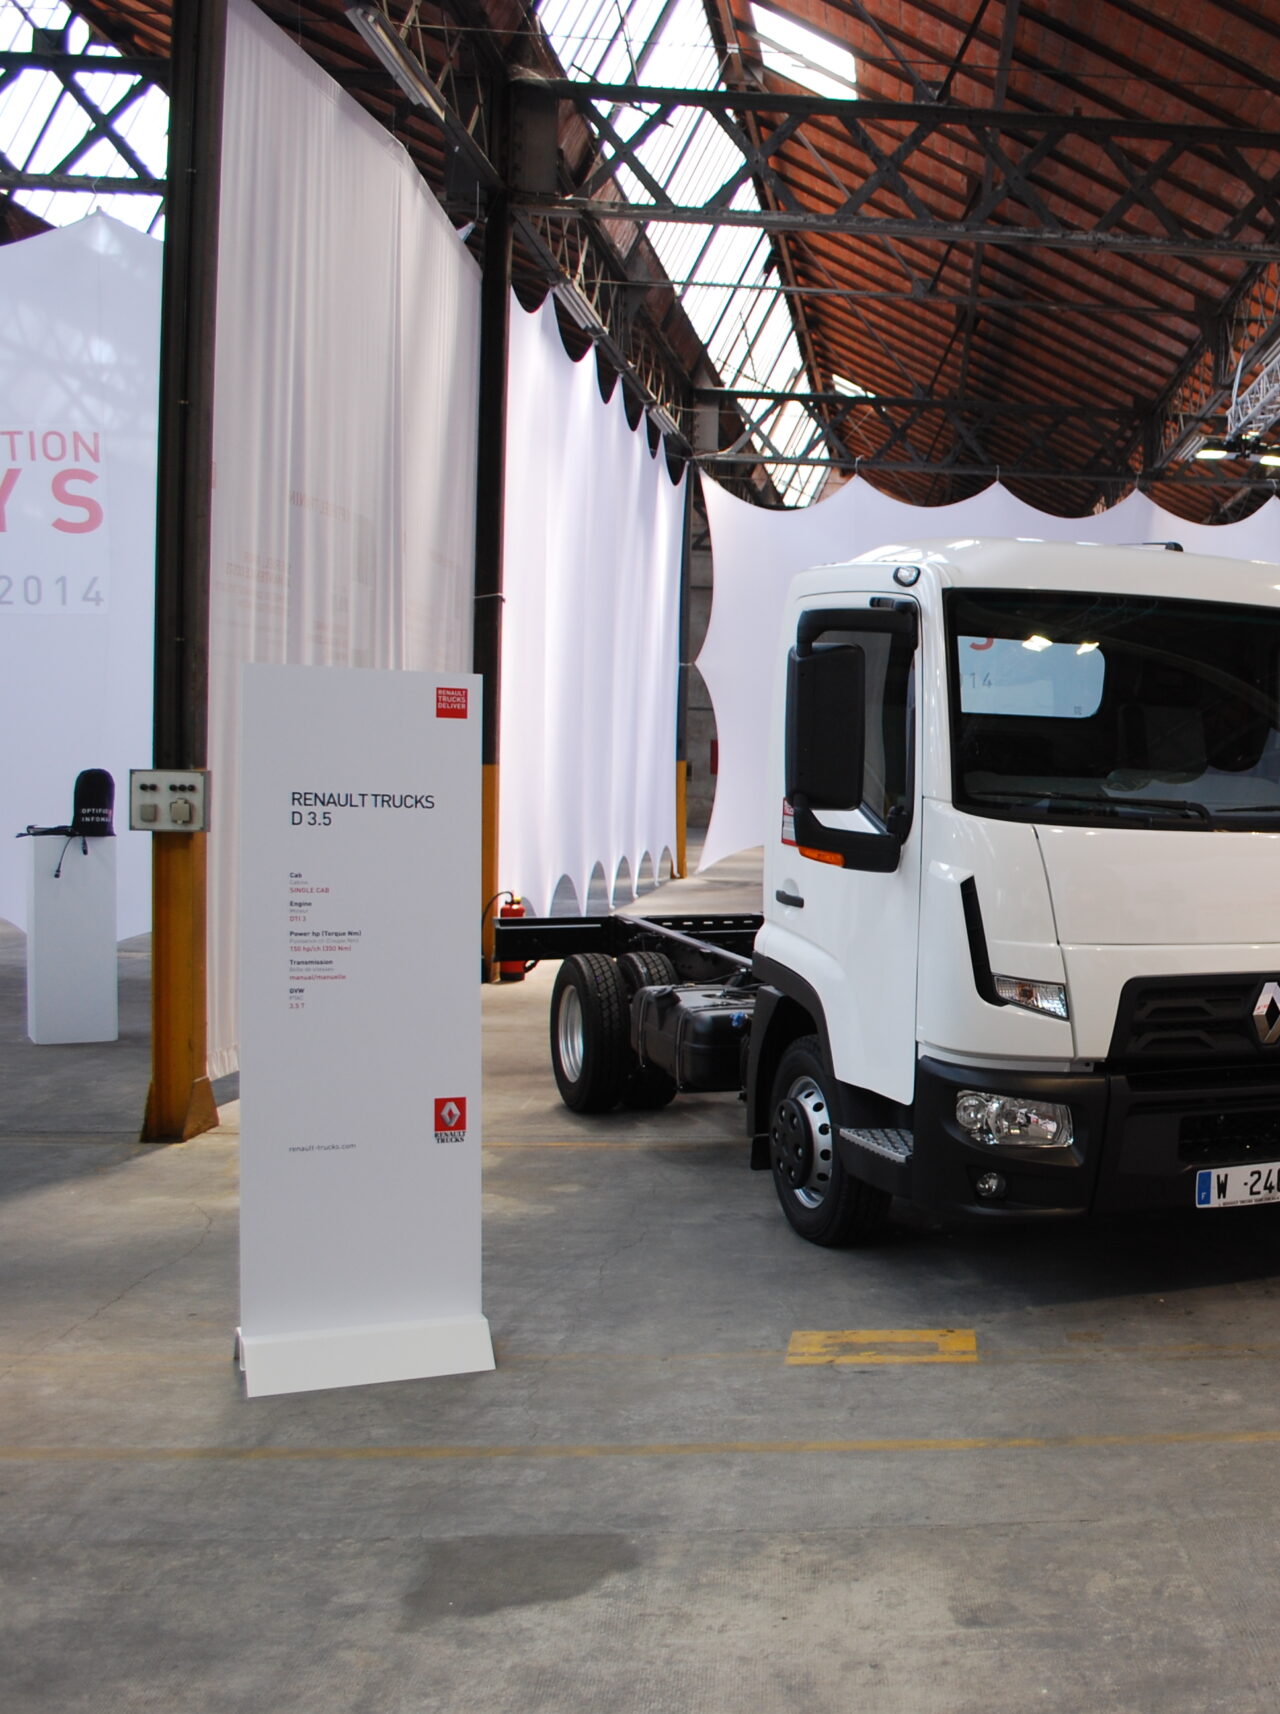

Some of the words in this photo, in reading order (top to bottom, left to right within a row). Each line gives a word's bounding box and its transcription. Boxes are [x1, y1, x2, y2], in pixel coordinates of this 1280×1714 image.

[0, 574, 104, 606] 2014
[291, 791, 368, 808] RENAULT
[371, 793, 435, 809] TRUCKS
[291, 811, 303, 826] D
[307, 811, 332, 826] 3.5
[289, 900, 312, 908] Engine
[289, 1143, 356, 1152] renault-trucks.com
[1216, 1173, 1229, 1199] W
